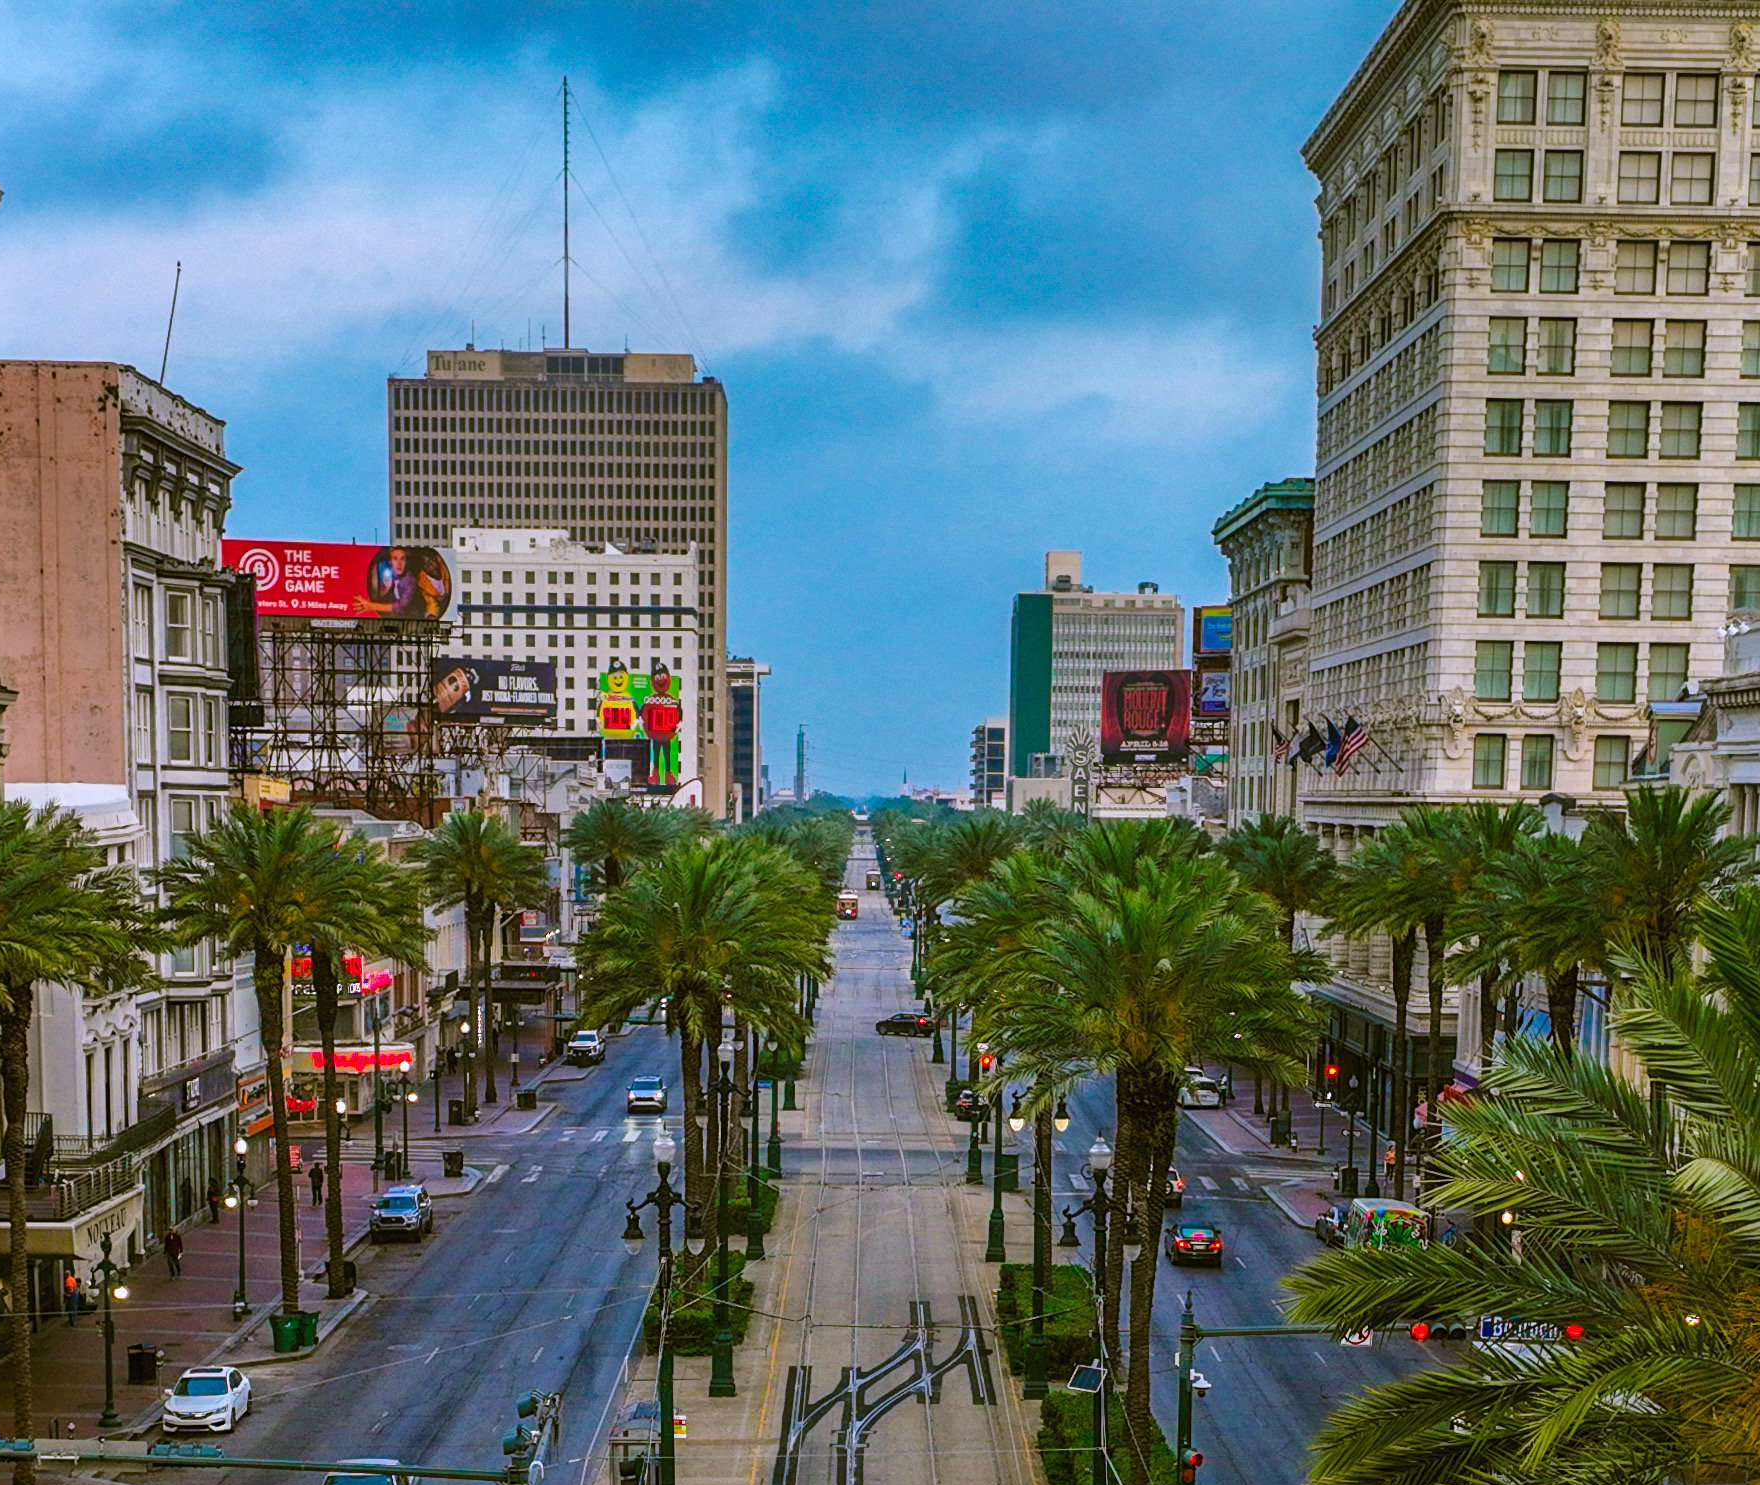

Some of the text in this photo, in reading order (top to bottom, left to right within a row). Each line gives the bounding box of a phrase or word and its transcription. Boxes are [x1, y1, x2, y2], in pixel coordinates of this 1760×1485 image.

[284, 549, 312, 563] THE
[284, 565, 339, 579] ESCAPE
[284, 580, 325, 593] GAME
[498, 676, 539, 691] NO FLAVORS.
[481, 690, 493, 702] JUST
[87, 1209, 126, 1247] NOUVEAU
